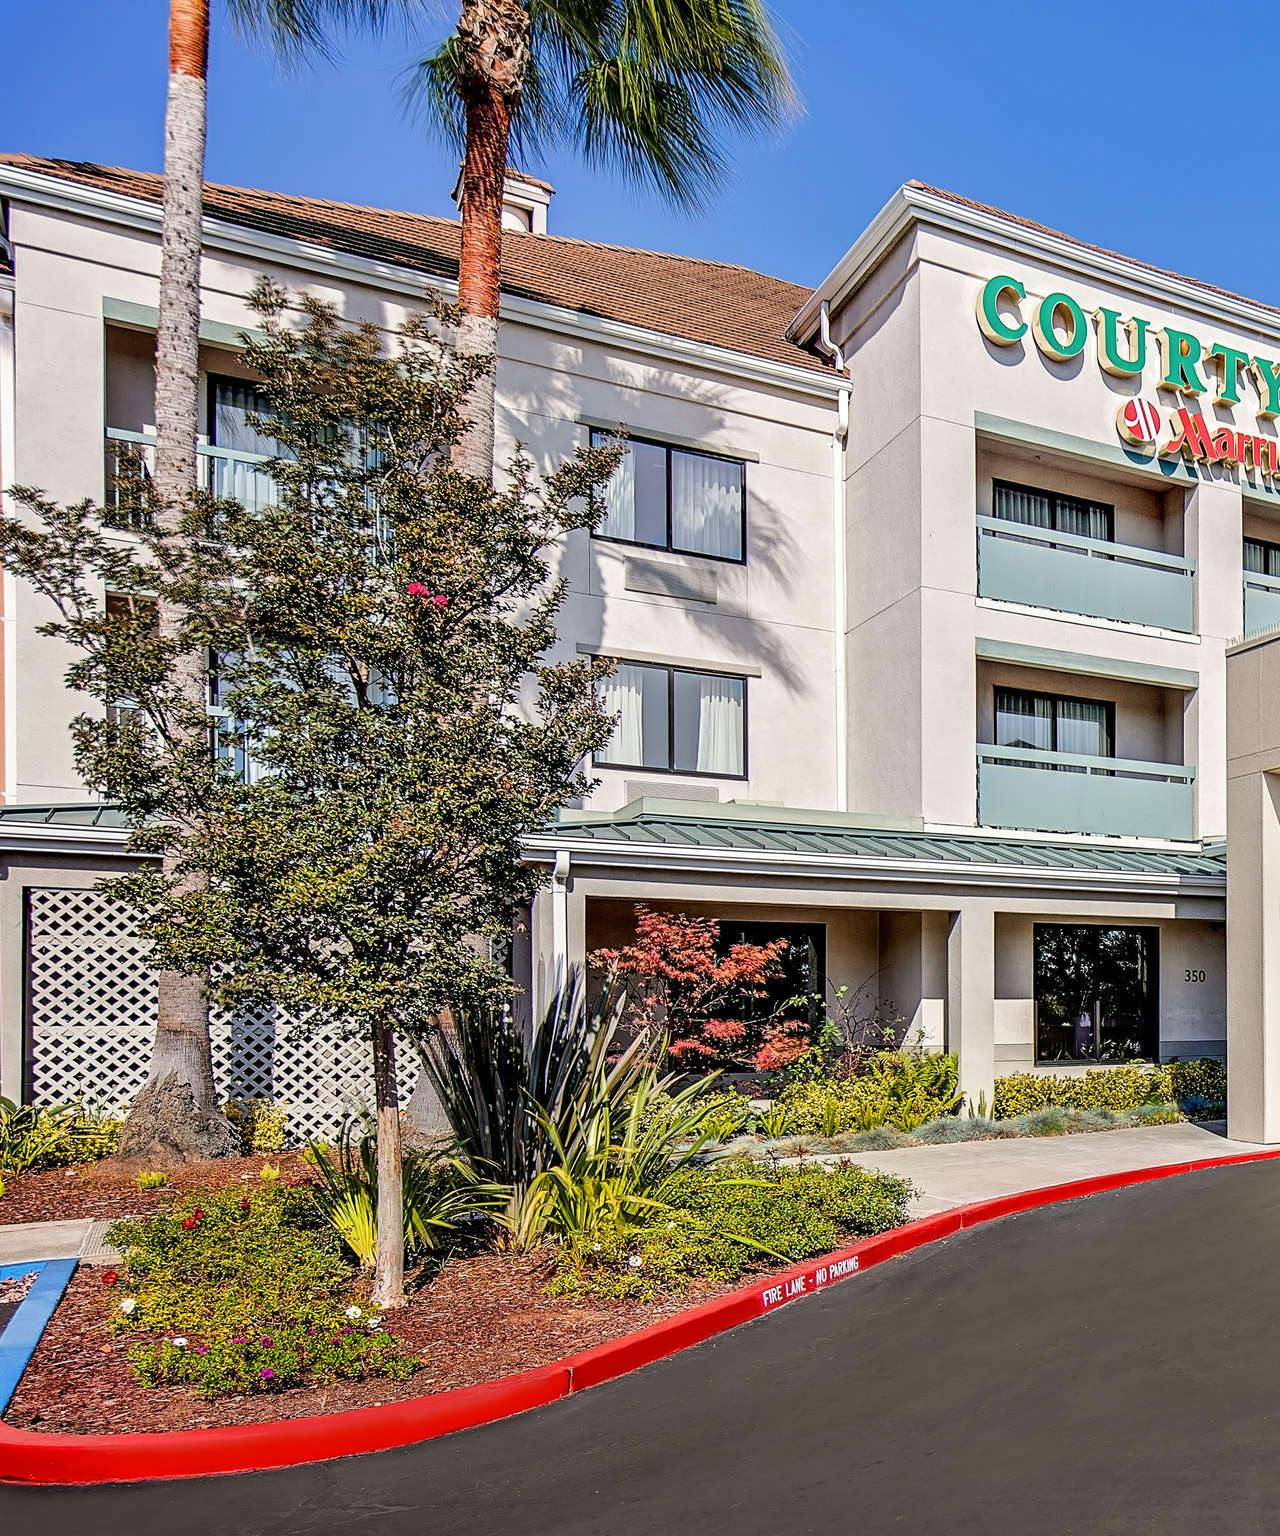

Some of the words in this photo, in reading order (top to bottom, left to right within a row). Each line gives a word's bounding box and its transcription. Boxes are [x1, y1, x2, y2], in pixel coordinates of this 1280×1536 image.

[1184, 969, 1206, 983] 350
[762, 1286, 783, 1307] FIRE
[785, 1275, 806, 1297] LANE
[815, 1269, 828, 1286] NO
[829, 1256, 859, 1280] PARKING
